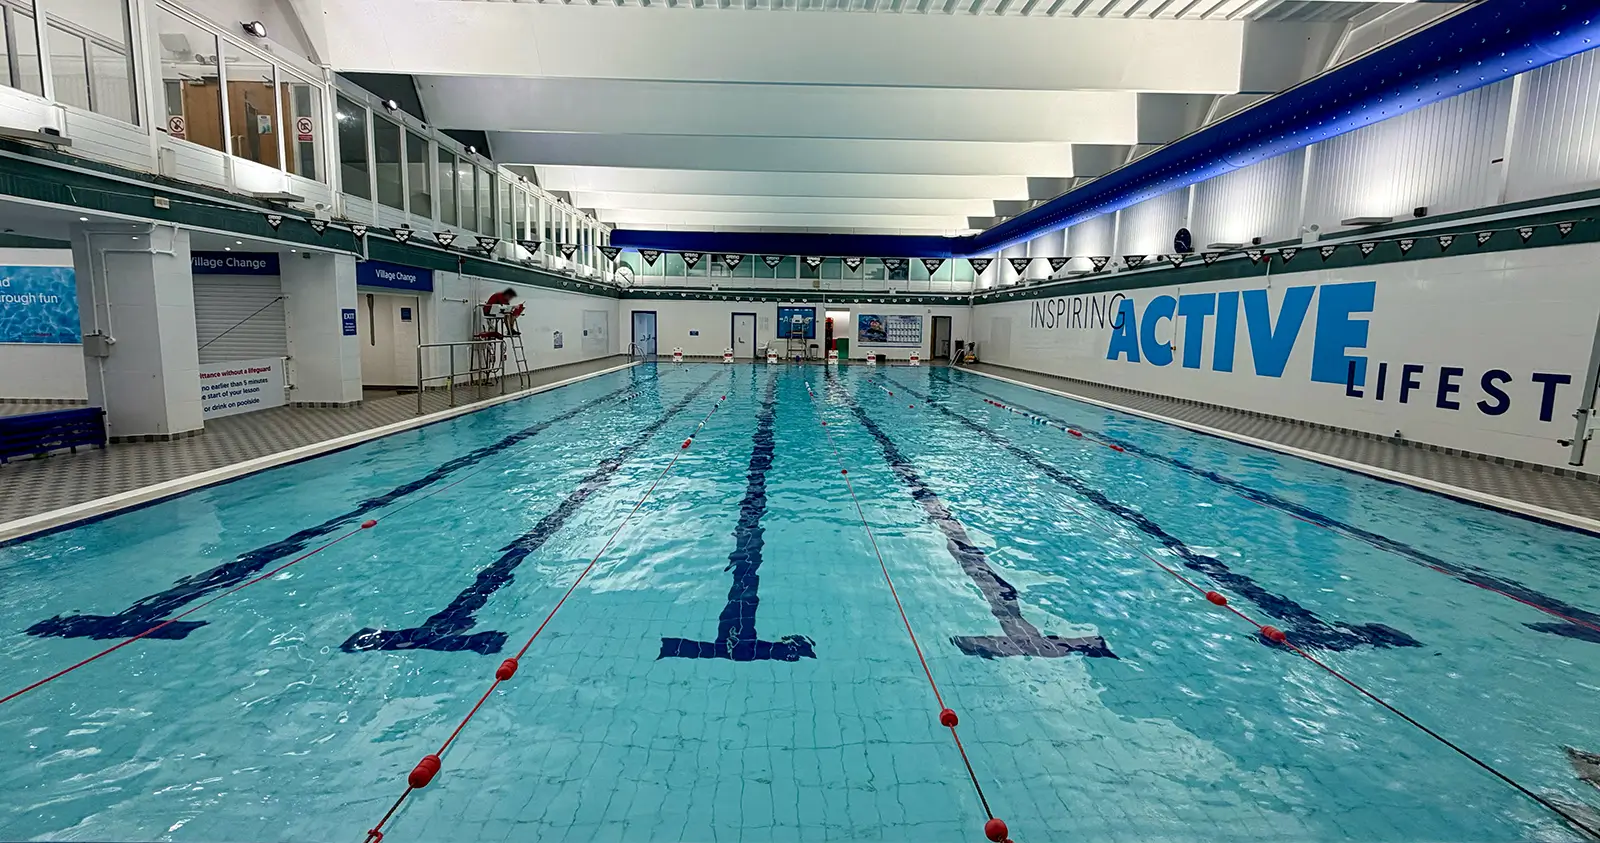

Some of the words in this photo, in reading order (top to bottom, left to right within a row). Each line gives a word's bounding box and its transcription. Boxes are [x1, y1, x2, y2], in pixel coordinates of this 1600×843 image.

[226, 258, 266, 269] Change
[375, 269, 396, 281] Village
[396, 272, 416, 283] Change
[39, 293, 58, 303] fun
[1030, 292, 1126, 330] INSPIRING
[1106, 281, 1376, 387] ACTIVE
[221, 369, 243, 377] without
[248, 366, 271, 374] lifeguard
[211, 382, 229, 390] earlier
[1346, 361, 1572, 422] LIFEST
[207, 391, 221, 399] start
[222, 389, 228, 397] of
[212, 402, 227, 411] drink
[237, 398, 260, 407] poolside
